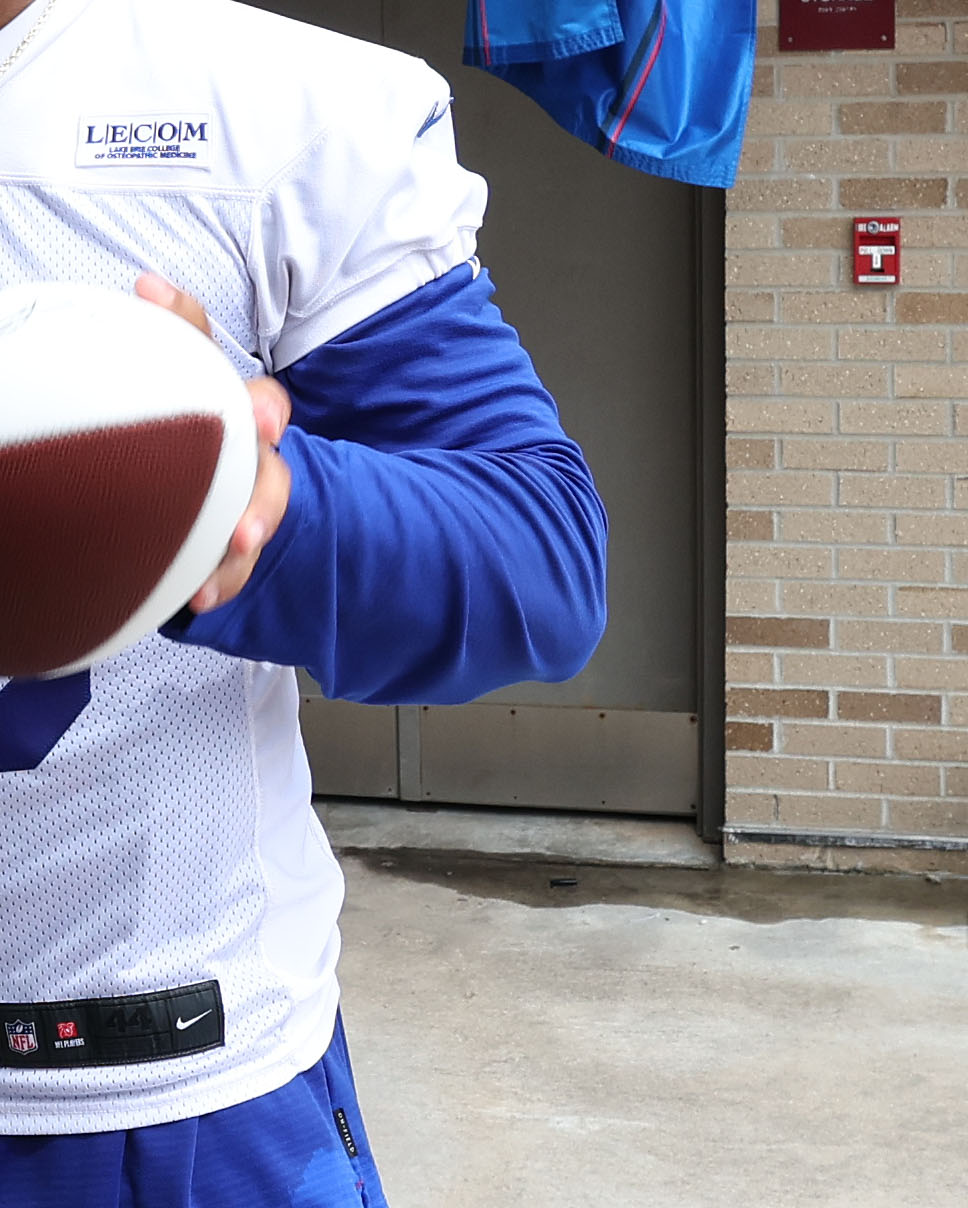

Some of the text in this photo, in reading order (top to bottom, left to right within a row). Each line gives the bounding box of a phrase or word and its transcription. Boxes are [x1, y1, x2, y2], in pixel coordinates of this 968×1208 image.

[147, 145, 180, 153] COLLEGE
[11, 1034, 35, 1051] NFL
[64, 1038, 85, 1048] PLAYERS
